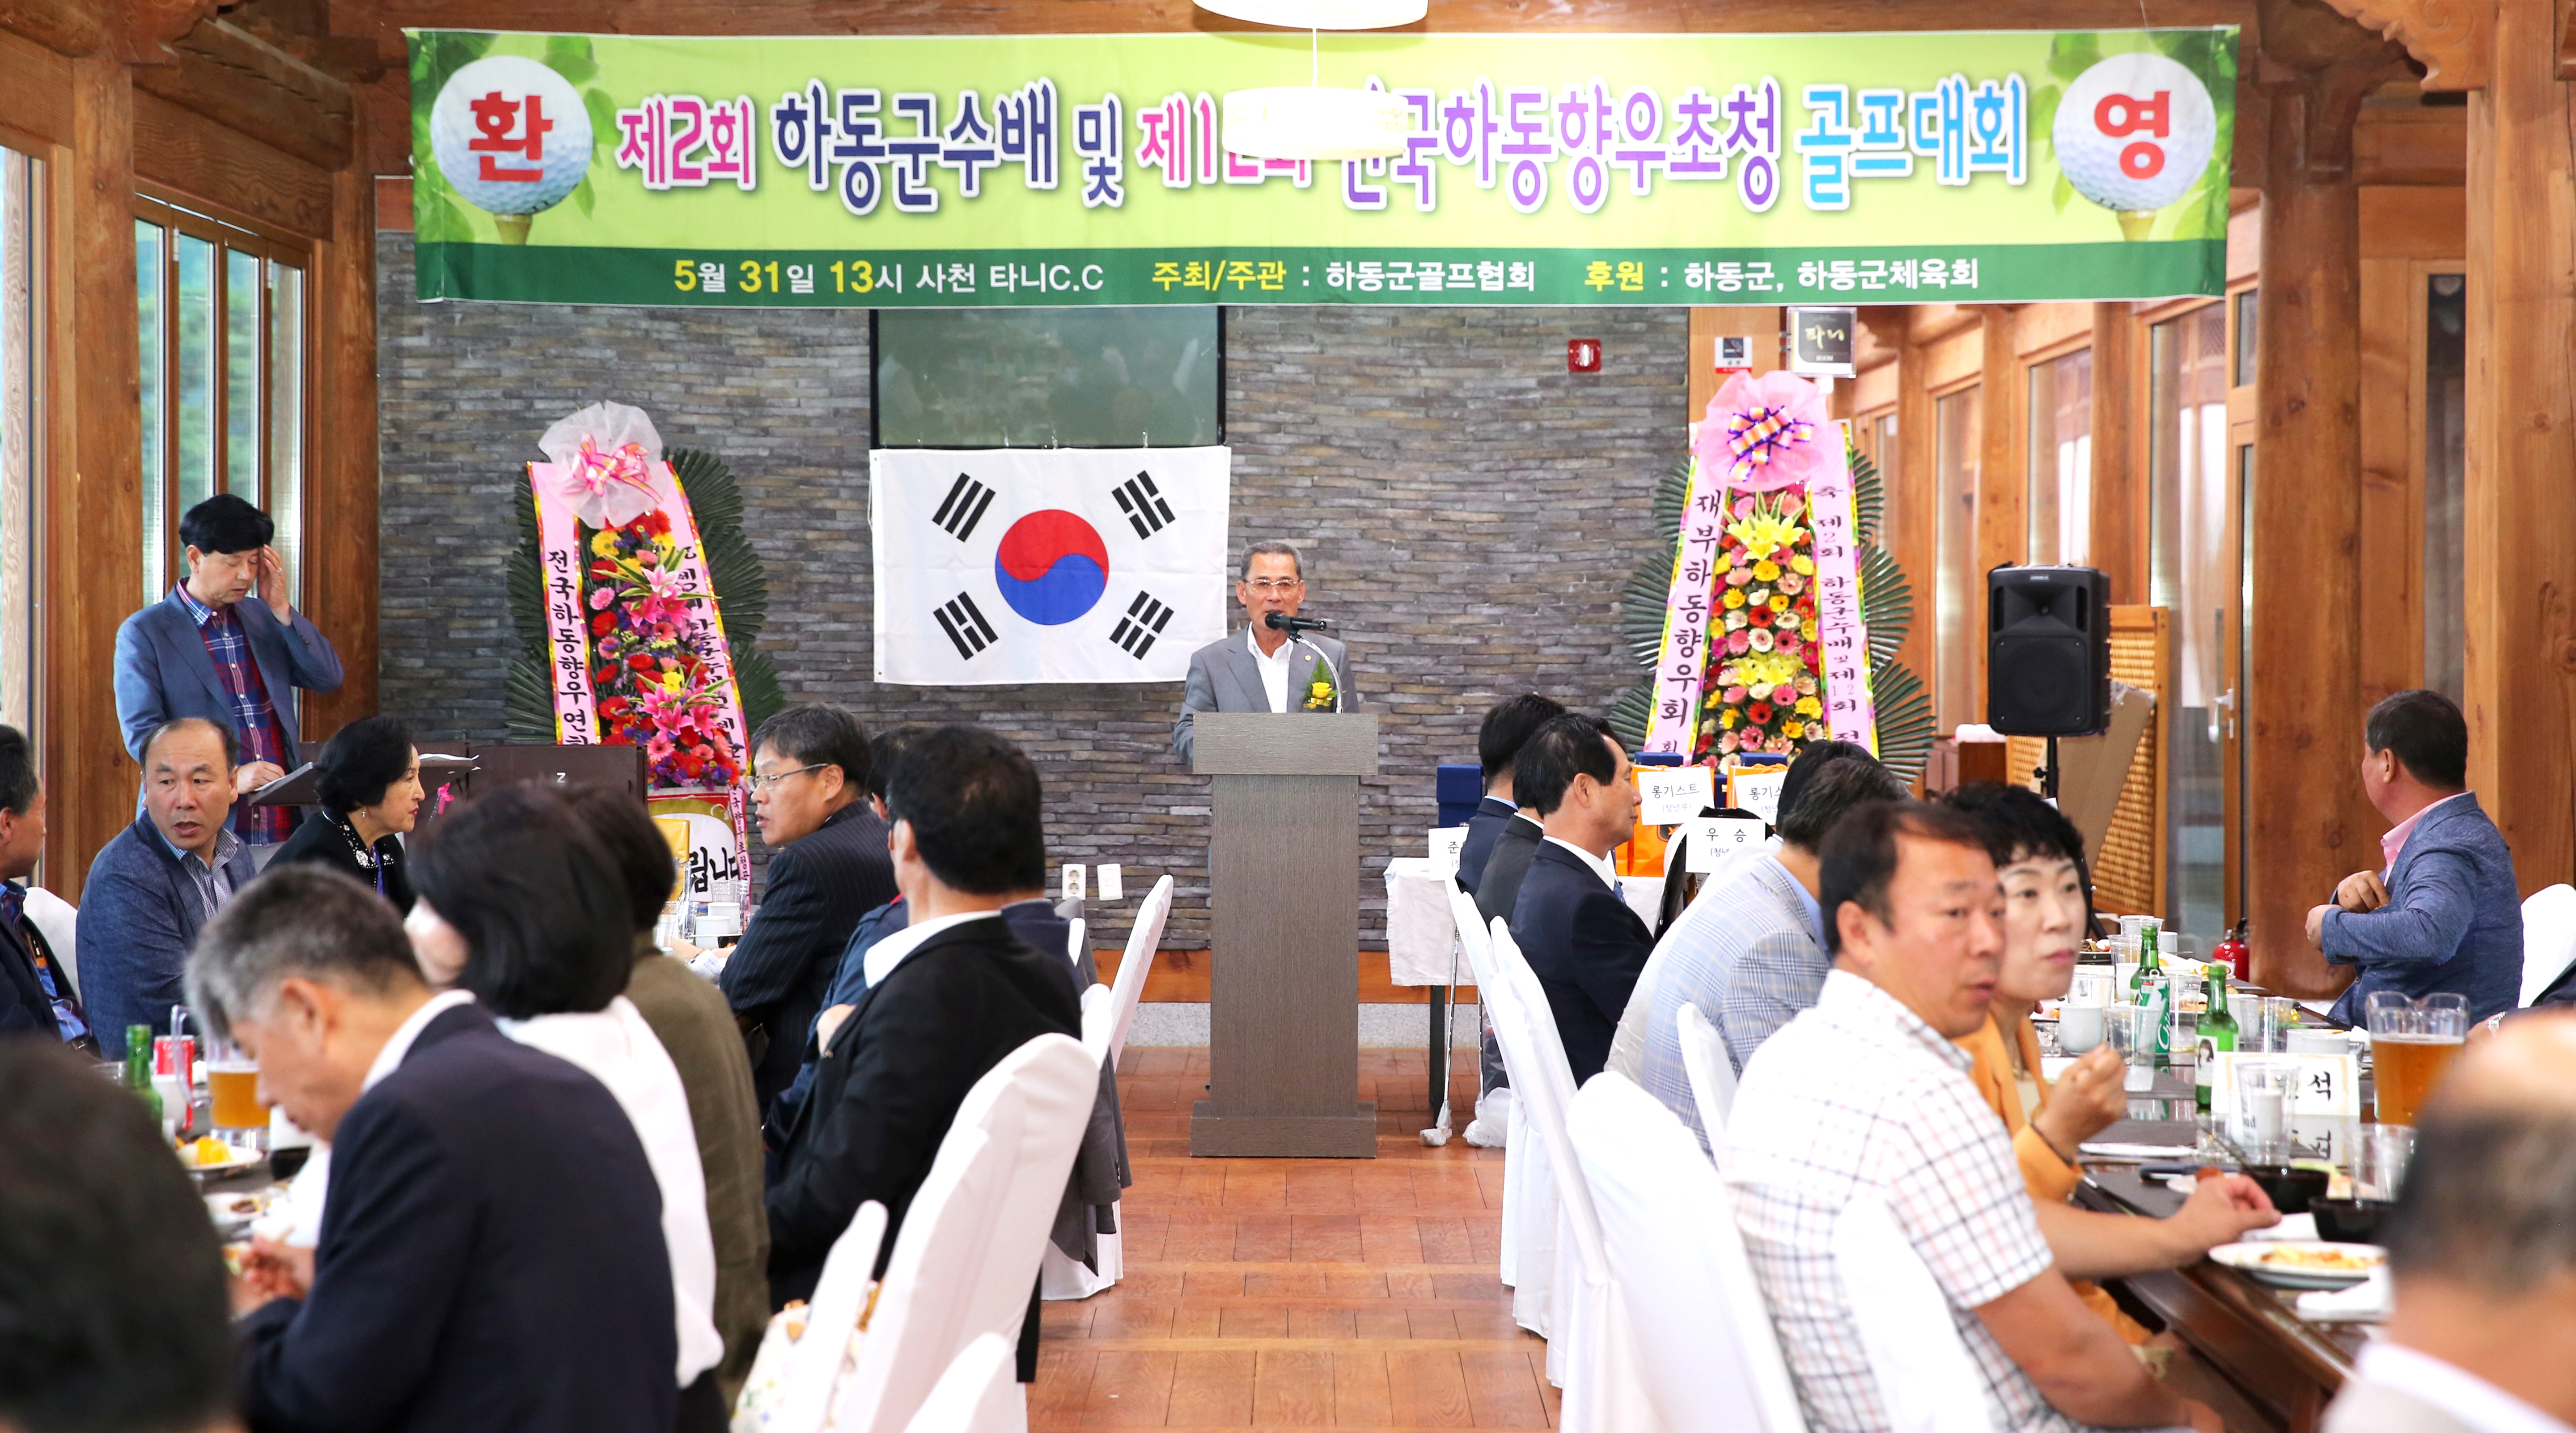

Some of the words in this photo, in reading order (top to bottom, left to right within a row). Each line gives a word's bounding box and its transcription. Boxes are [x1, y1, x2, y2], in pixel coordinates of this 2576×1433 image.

[468, 91, 553, 182] 환
[621, 99, 750, 185] 제2회
[775, 83, 1053, 209] 하동군수배
[1078, 98, 1120, 203] 및
[1800, 78, 2021, 204] 골프대회
[2094, 90, 2171, 181] 영
[674, 259, 728, 294] 5월
[738, 261, 816, 295] 31일
[828, 260, 903, 295] 13시
[916, 262, 977, 295] 사천
[989, 263, 1104, 294] 타니C.C
[1151, 259, 1287, 292] 주최/주관
[1325, 261, 1535, 292] 하동군골프협회
[1584, 260, 1645, 292] 후원
[1683, 260, 1784, 294] 하동군,
[1797, 257, 1979, 290] 하동군체육회
[1816, 515, 1843, 558] 제2회
[1661, 489, 1722, 728] 재부하동향우회
[1651, 783, 1700, 799] 롱기스트
